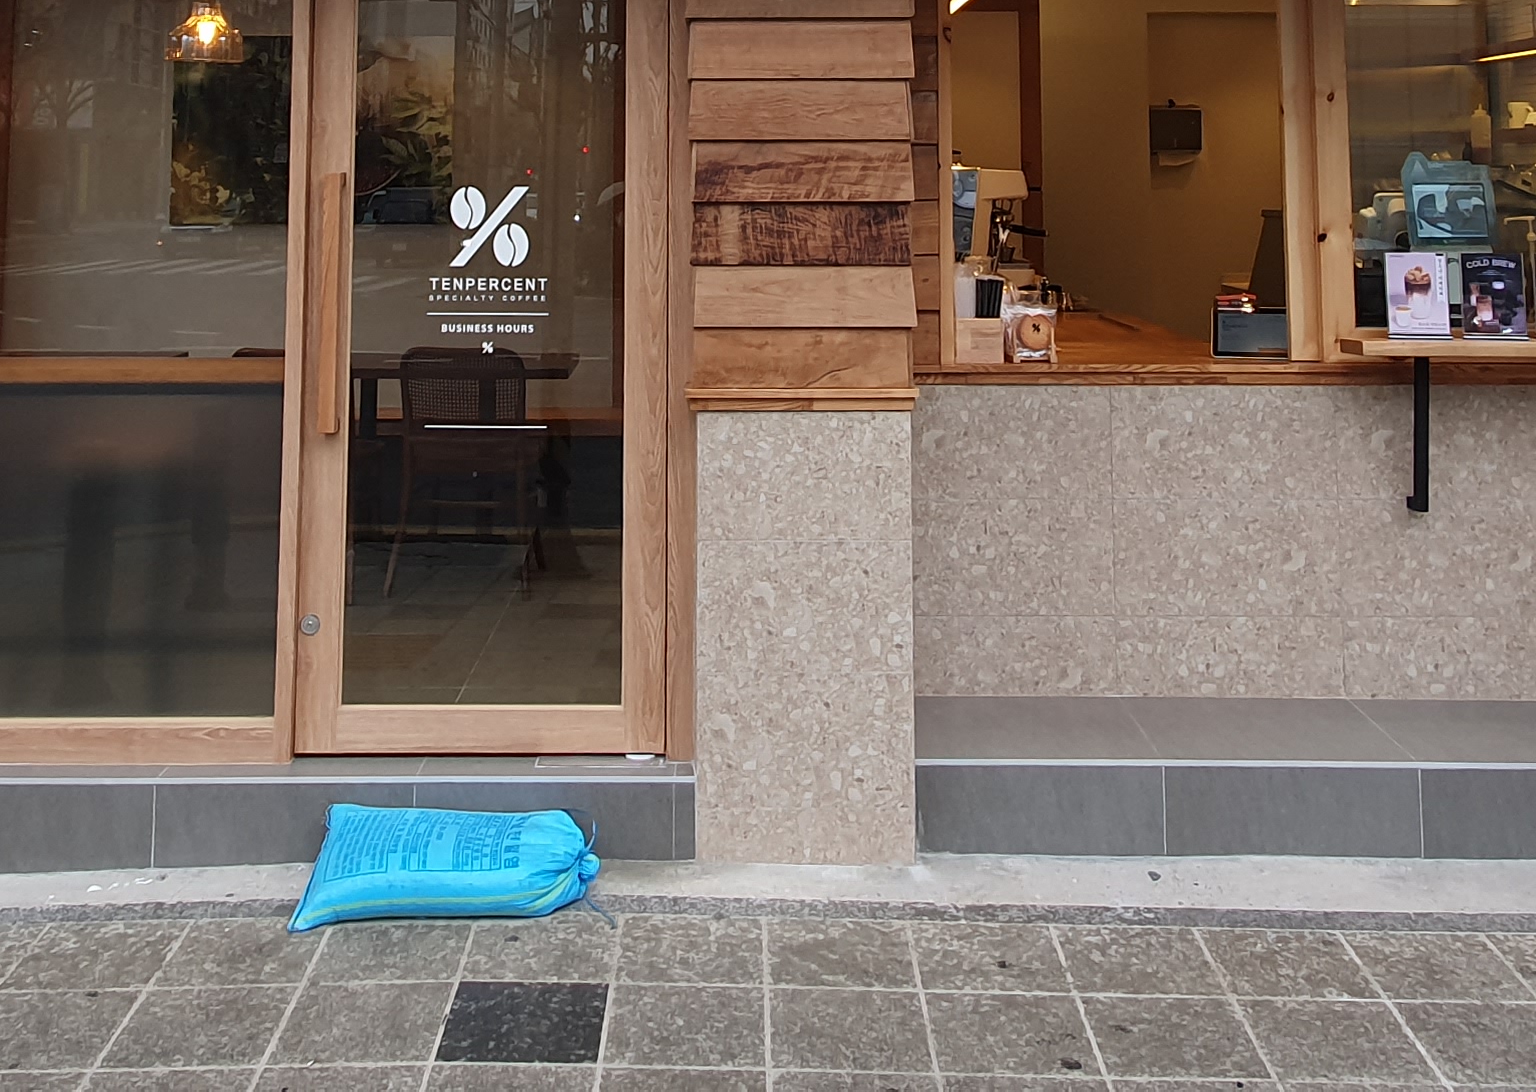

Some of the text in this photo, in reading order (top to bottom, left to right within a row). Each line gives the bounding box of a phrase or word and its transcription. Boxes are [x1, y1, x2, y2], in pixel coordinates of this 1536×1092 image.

[1466, 259, 1489, 268] COLD
[429, 278, 548, 291] TENPERCENT
[441, 324, 534, 333] BUSINESS HOURS
